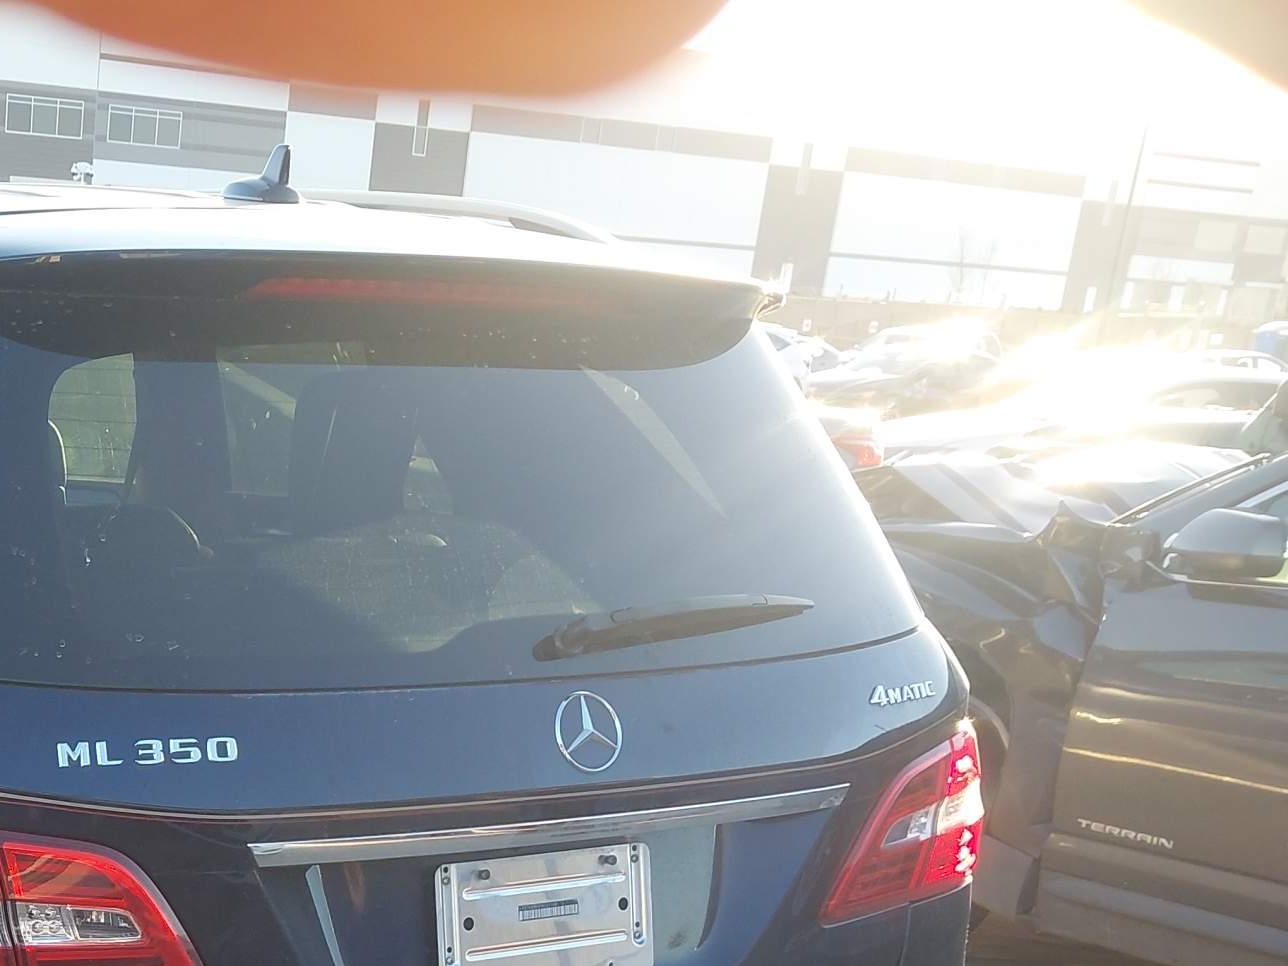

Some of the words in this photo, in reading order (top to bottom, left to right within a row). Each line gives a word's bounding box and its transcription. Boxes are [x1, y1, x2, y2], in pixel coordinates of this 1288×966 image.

[869, 680, 937, 707] 4MATIC
[56, 740, 124, 768] ML
[134, 736, 239, 765] 350
[1077, 818, 1174, 849] TERRAIN
